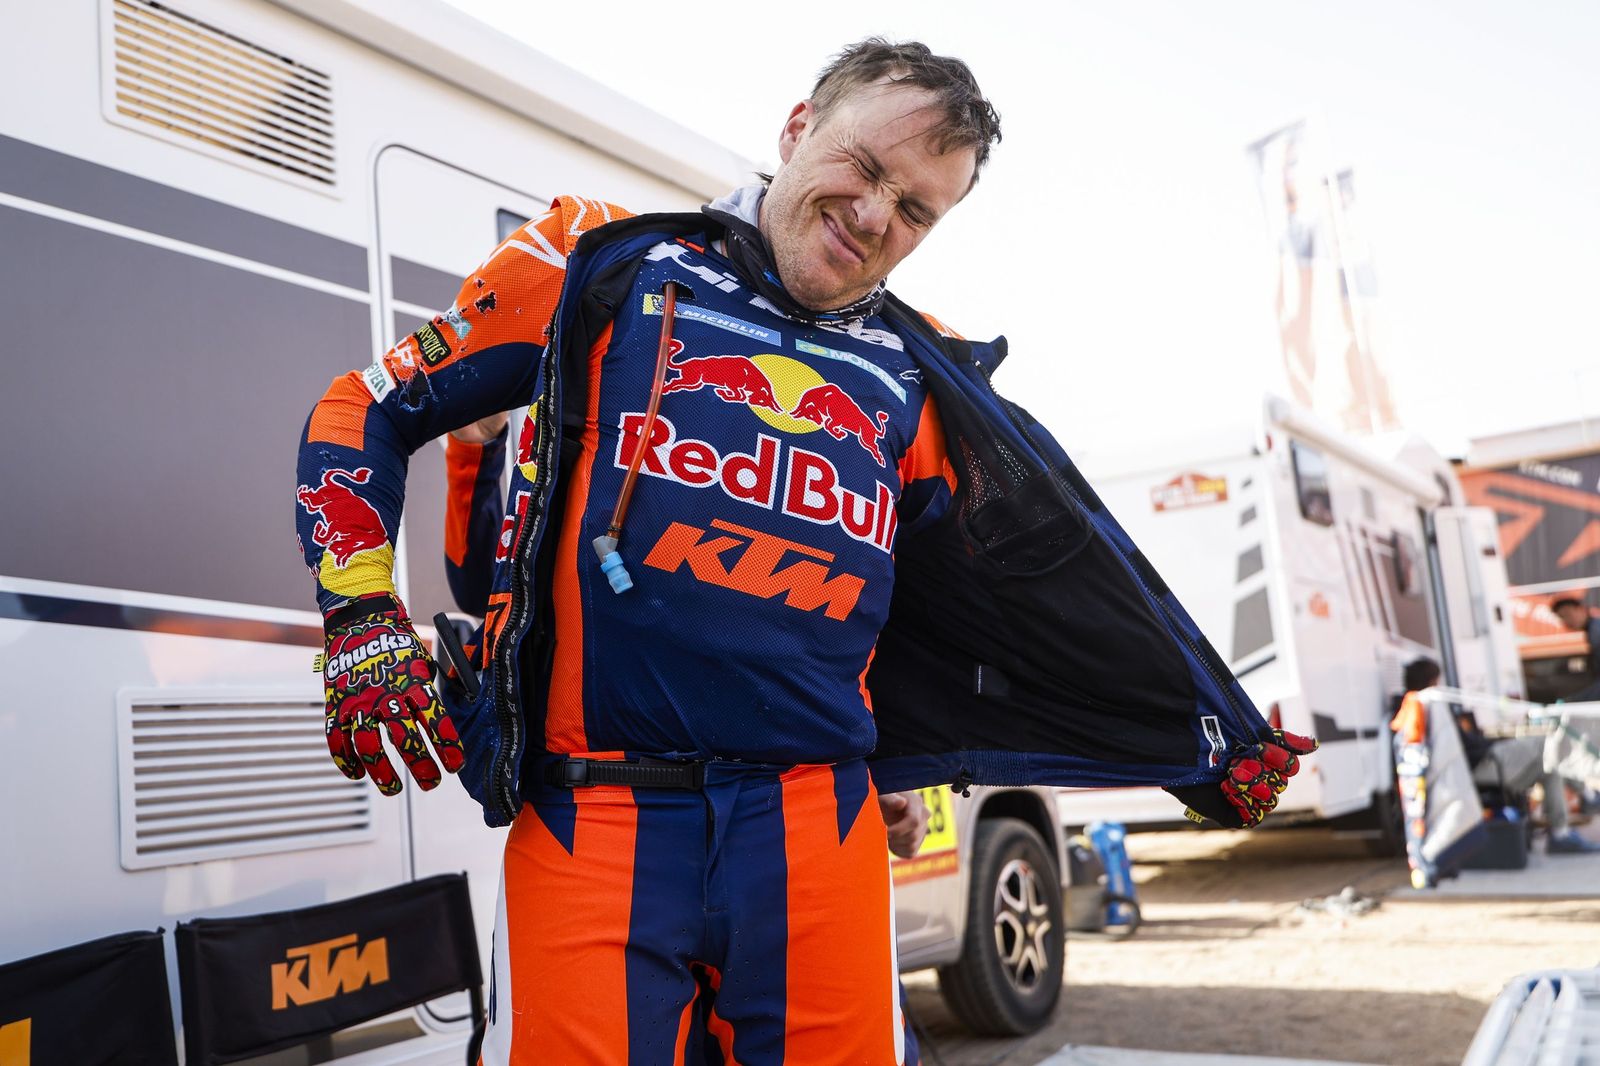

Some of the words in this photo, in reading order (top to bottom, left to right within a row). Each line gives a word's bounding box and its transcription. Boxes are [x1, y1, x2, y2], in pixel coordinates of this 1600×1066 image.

[683, 310, 769, 338] MICHELIN
[614, 412, 782, 510] Red
[782, 446, 898, 555] Bull
[642, 518, 866, 622] KTM
[271, 933, 390, 1011] KTM
